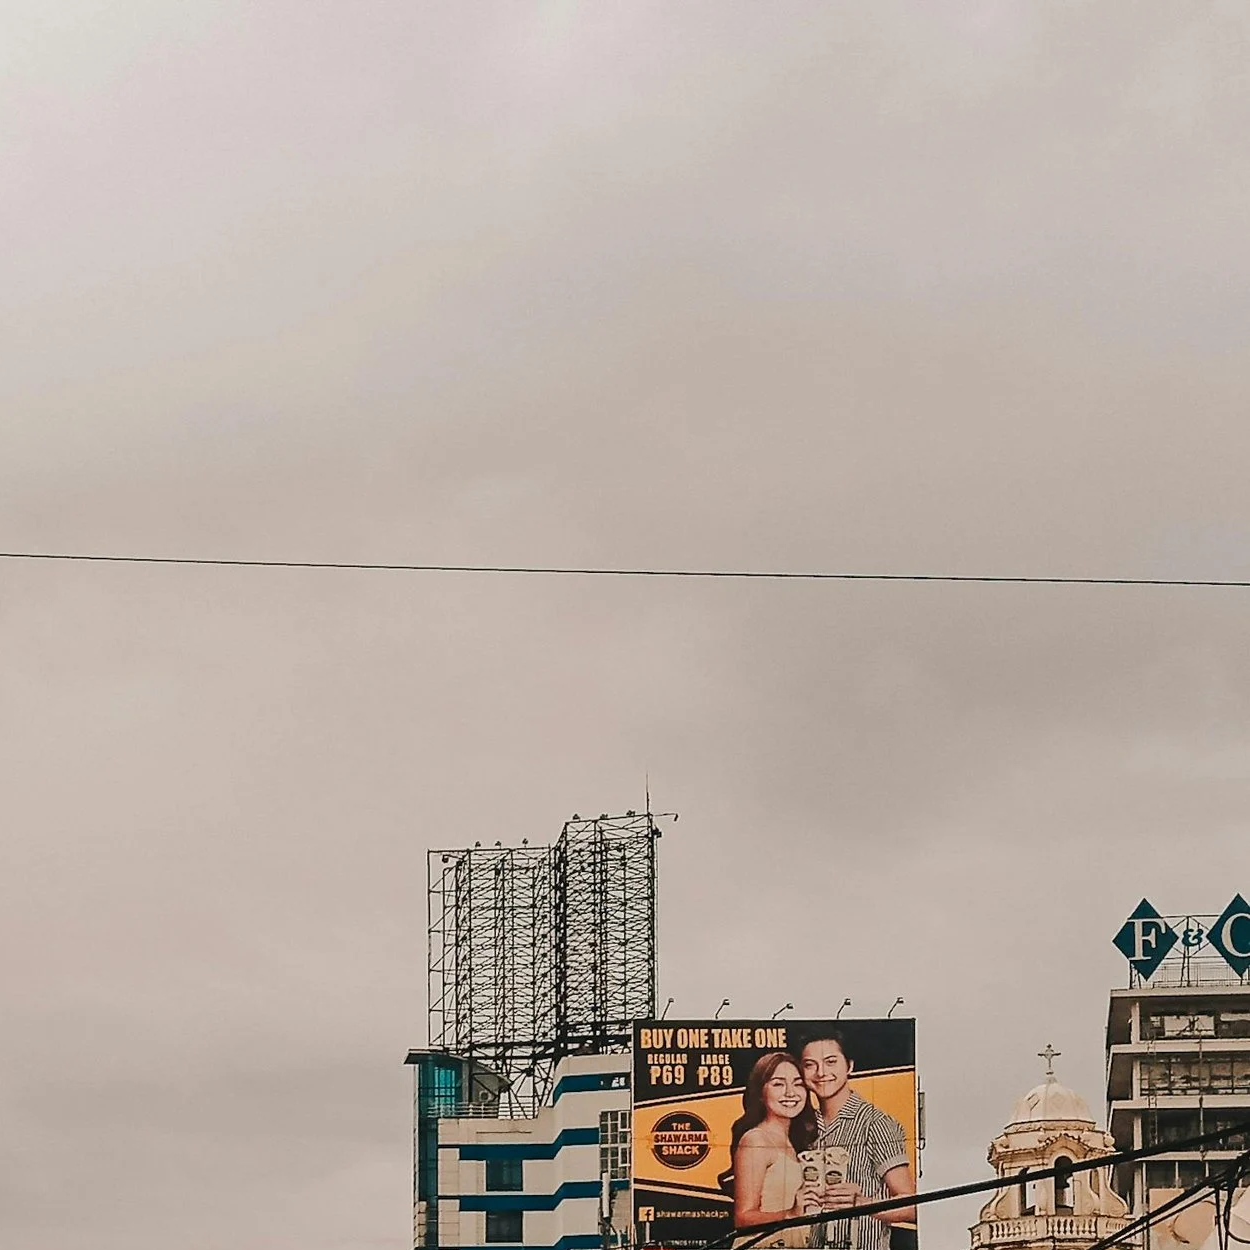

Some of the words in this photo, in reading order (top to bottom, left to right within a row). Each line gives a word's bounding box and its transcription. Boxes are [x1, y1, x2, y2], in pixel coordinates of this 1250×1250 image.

[1127, 918, 1166, 960] F
[1181, 928, 1205, 947] &
[640, 1028, 673, 1049] BUY
[676, 1028, 708, 1049] ONE
[711, 1028, 751, 1049] TAKE
[754, 1028, 787, 1049] ONE
[647, 1053, 688, 1065] REGULAR
[700, 1054, 730, 1065] LARGE
[672, 1122, 691, 1131] THE
[654, 1133, 709, 1143] SHAWARMA
[662, 1145, 700, 1156] SHACK
